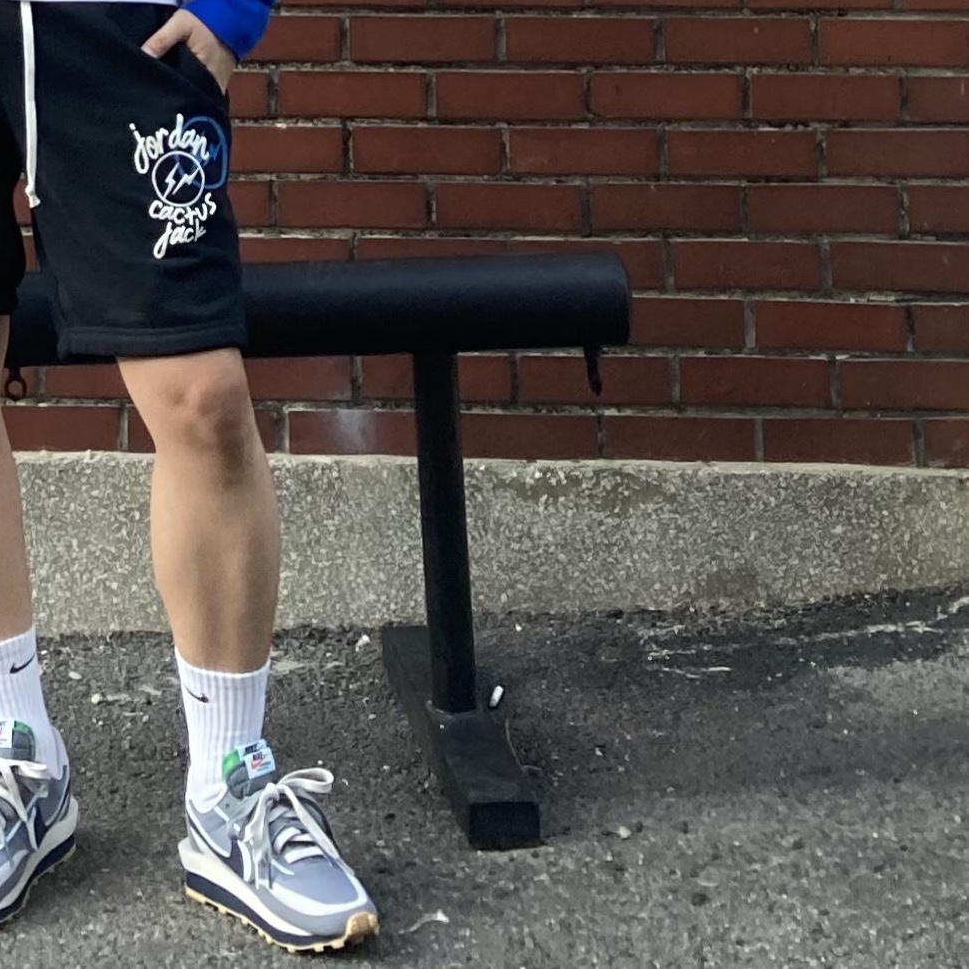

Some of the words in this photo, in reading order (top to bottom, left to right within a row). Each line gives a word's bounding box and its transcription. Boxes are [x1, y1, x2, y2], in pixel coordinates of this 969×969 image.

[129, 113, 209, 174] jordan
[148, 192, 217, 225] cactus
[153, 218, 207, 259] jack
